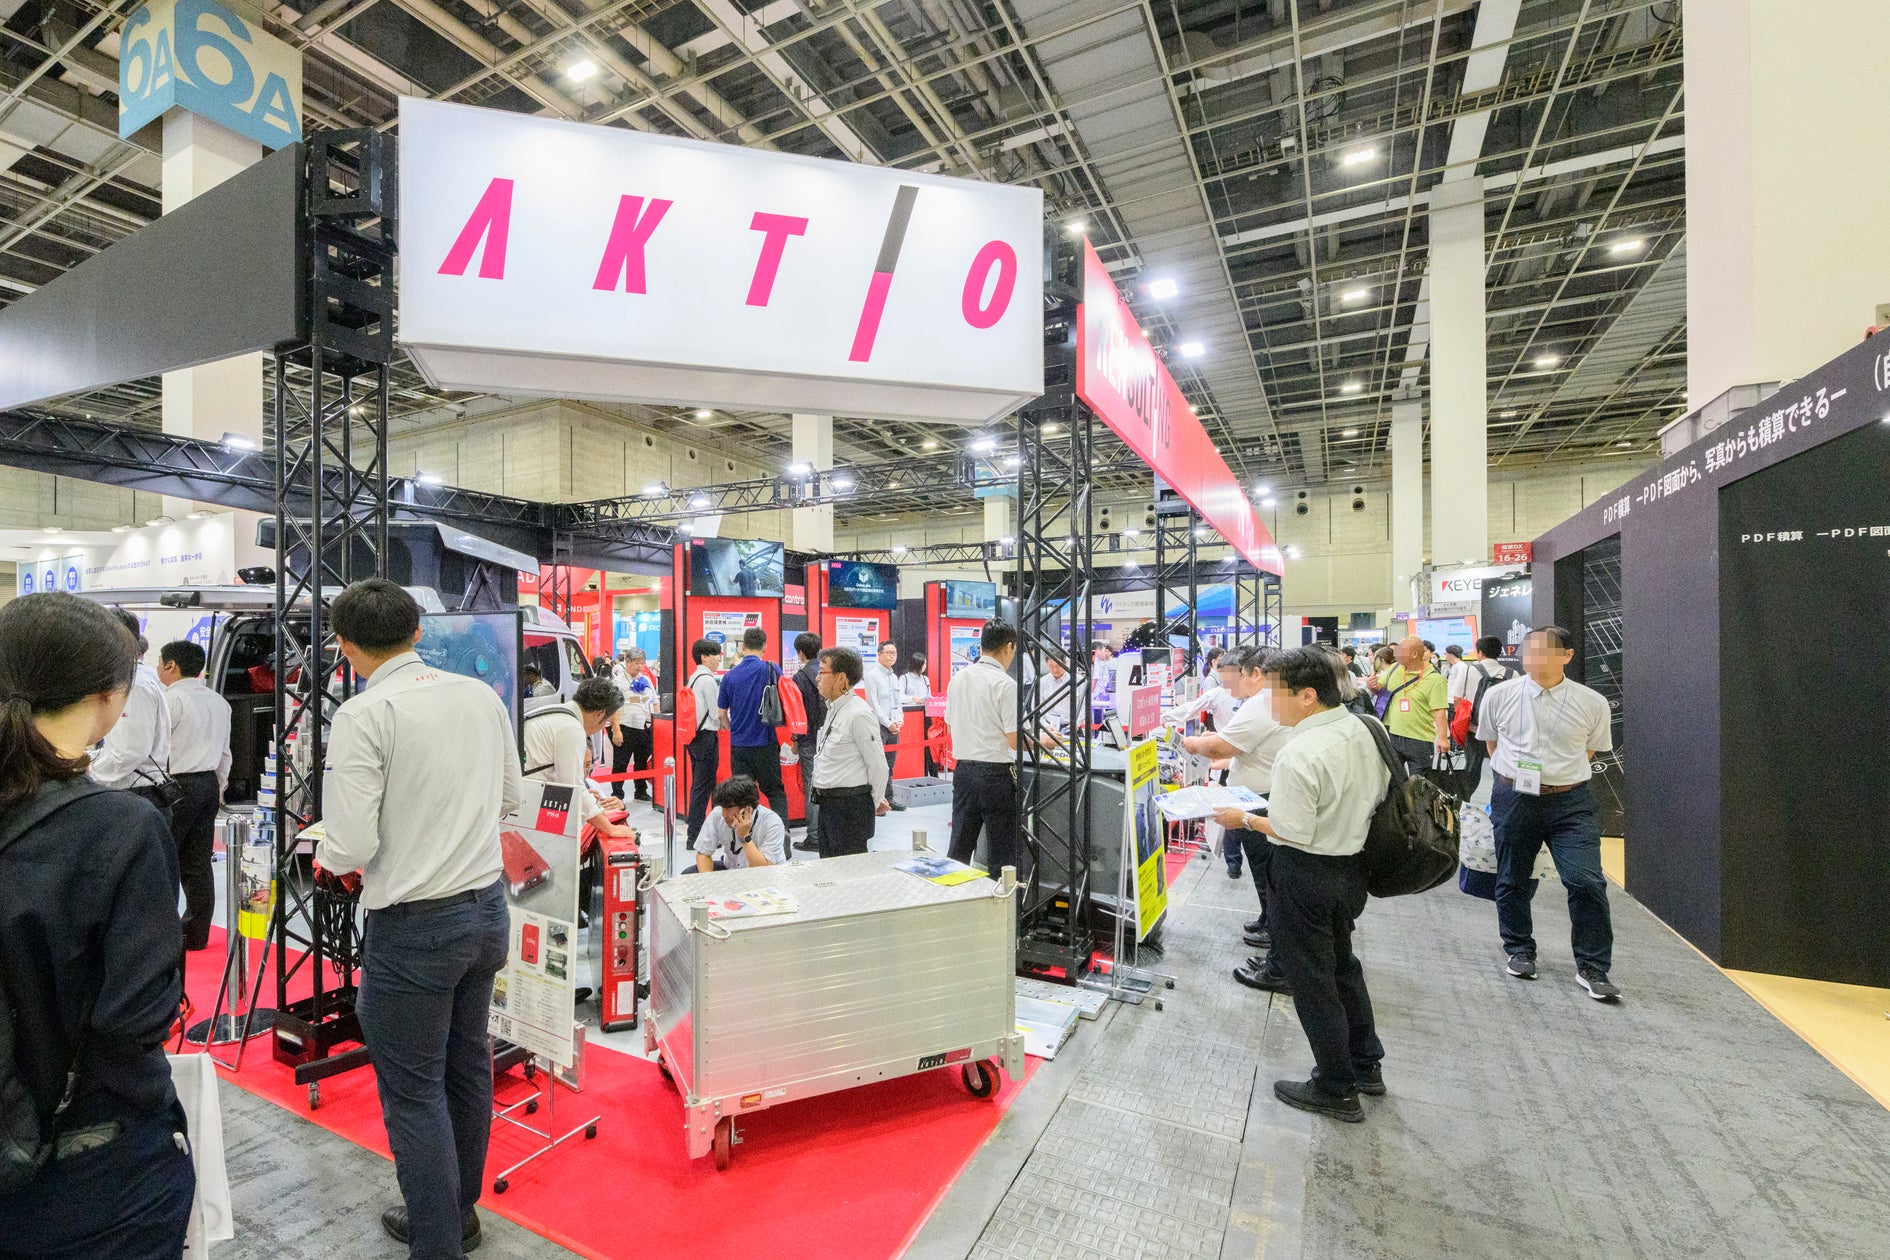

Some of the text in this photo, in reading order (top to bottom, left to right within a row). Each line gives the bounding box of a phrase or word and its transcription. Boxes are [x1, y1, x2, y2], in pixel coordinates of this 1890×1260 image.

[121, 4, 174, 111] 6A
[178, 0, 297, 133] 6A
[437, 177, 1017, 362] AKTIO
[1498, 553, 1528, 562] 16-26
[1741, 530, 1804, 543] PDF積算
[543, 799, 568, 811] AKTIO
